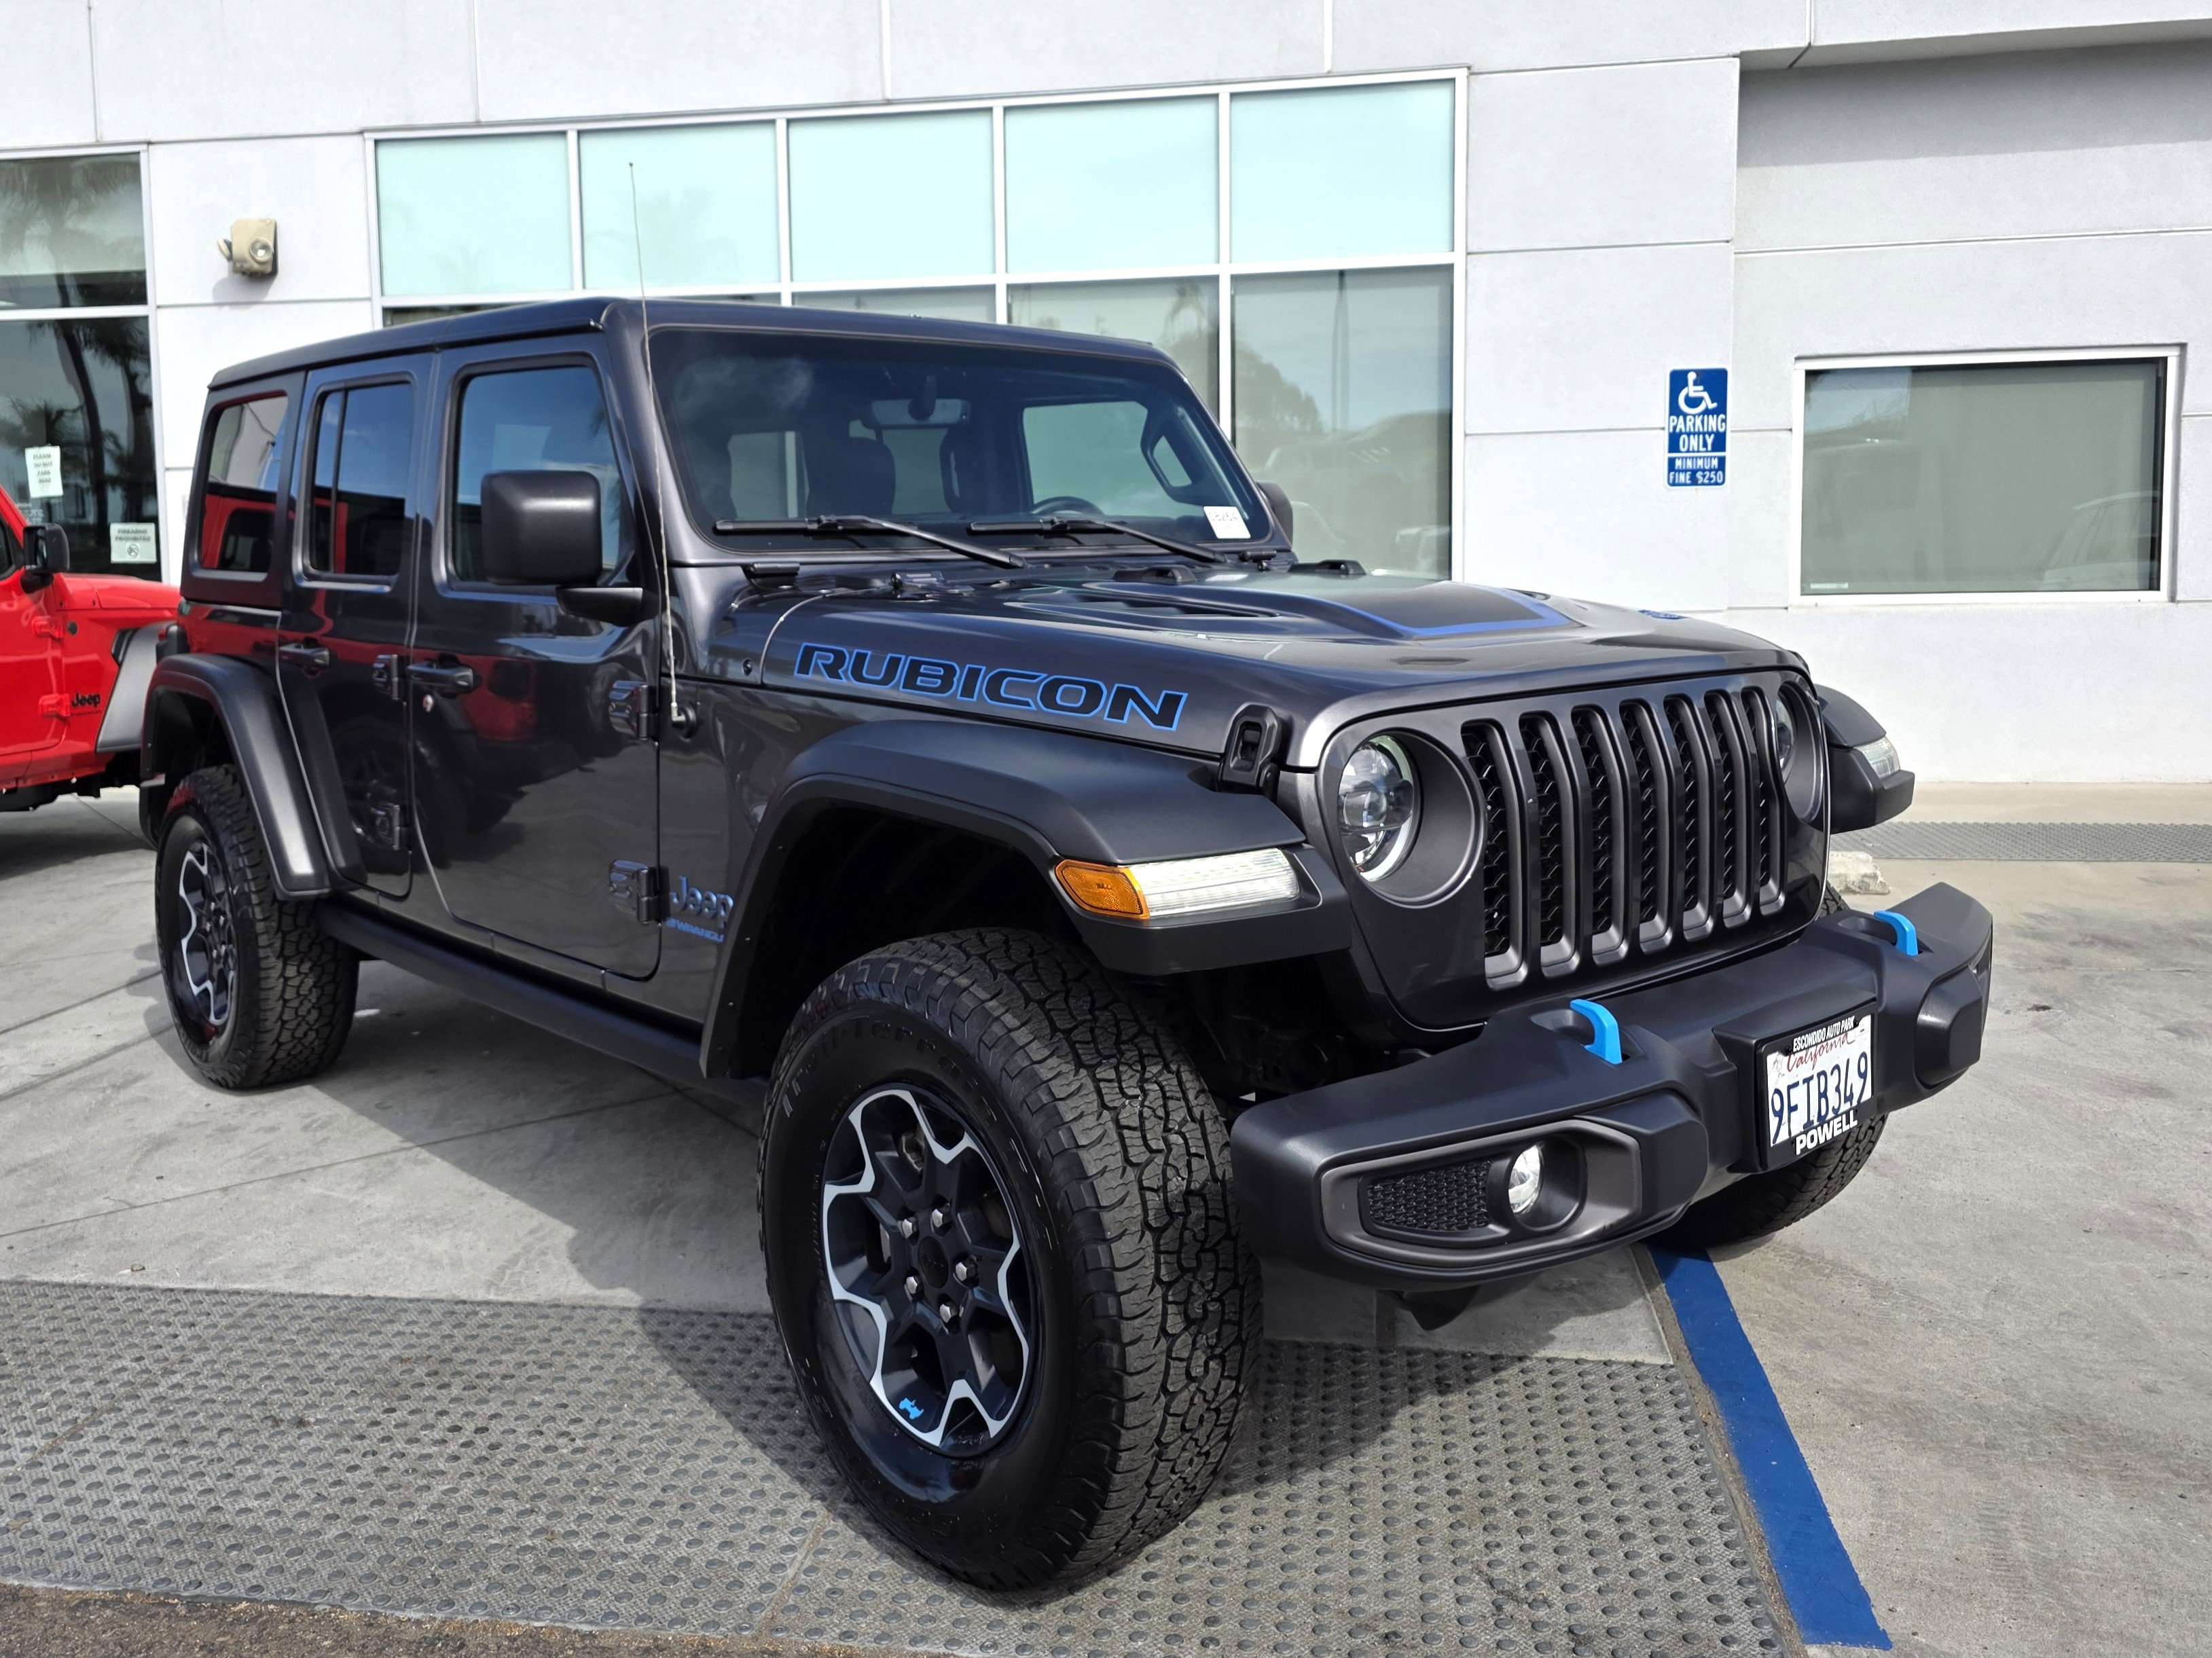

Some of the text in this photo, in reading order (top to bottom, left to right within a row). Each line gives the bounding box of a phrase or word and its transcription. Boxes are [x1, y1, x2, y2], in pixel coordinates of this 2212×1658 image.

[1669, 413, 1726, 433] PARKING
[1679, 433, 1715, 452] ONLY
[1669, 471, 1724, 484] FINE $250
[1675, 457, 1718, 470] MINIMUM
[71, 693, 101, 707] Jeep
[794, 642, 1189, 731] RUBICON
[669, 875, 734, 929] Jeep
[1787, 1031, 1855, 1072] California
[1792, 1027, 1826, 1052] ESCONDIDO
[1826, 1020, 1841, 1040] AUTO
[1841, 1015, 1855, 1033] PARK
[1771, 1051, 1868, 1144] 9FIB349
[1796, 1109, 1858, 1156] POWELL
